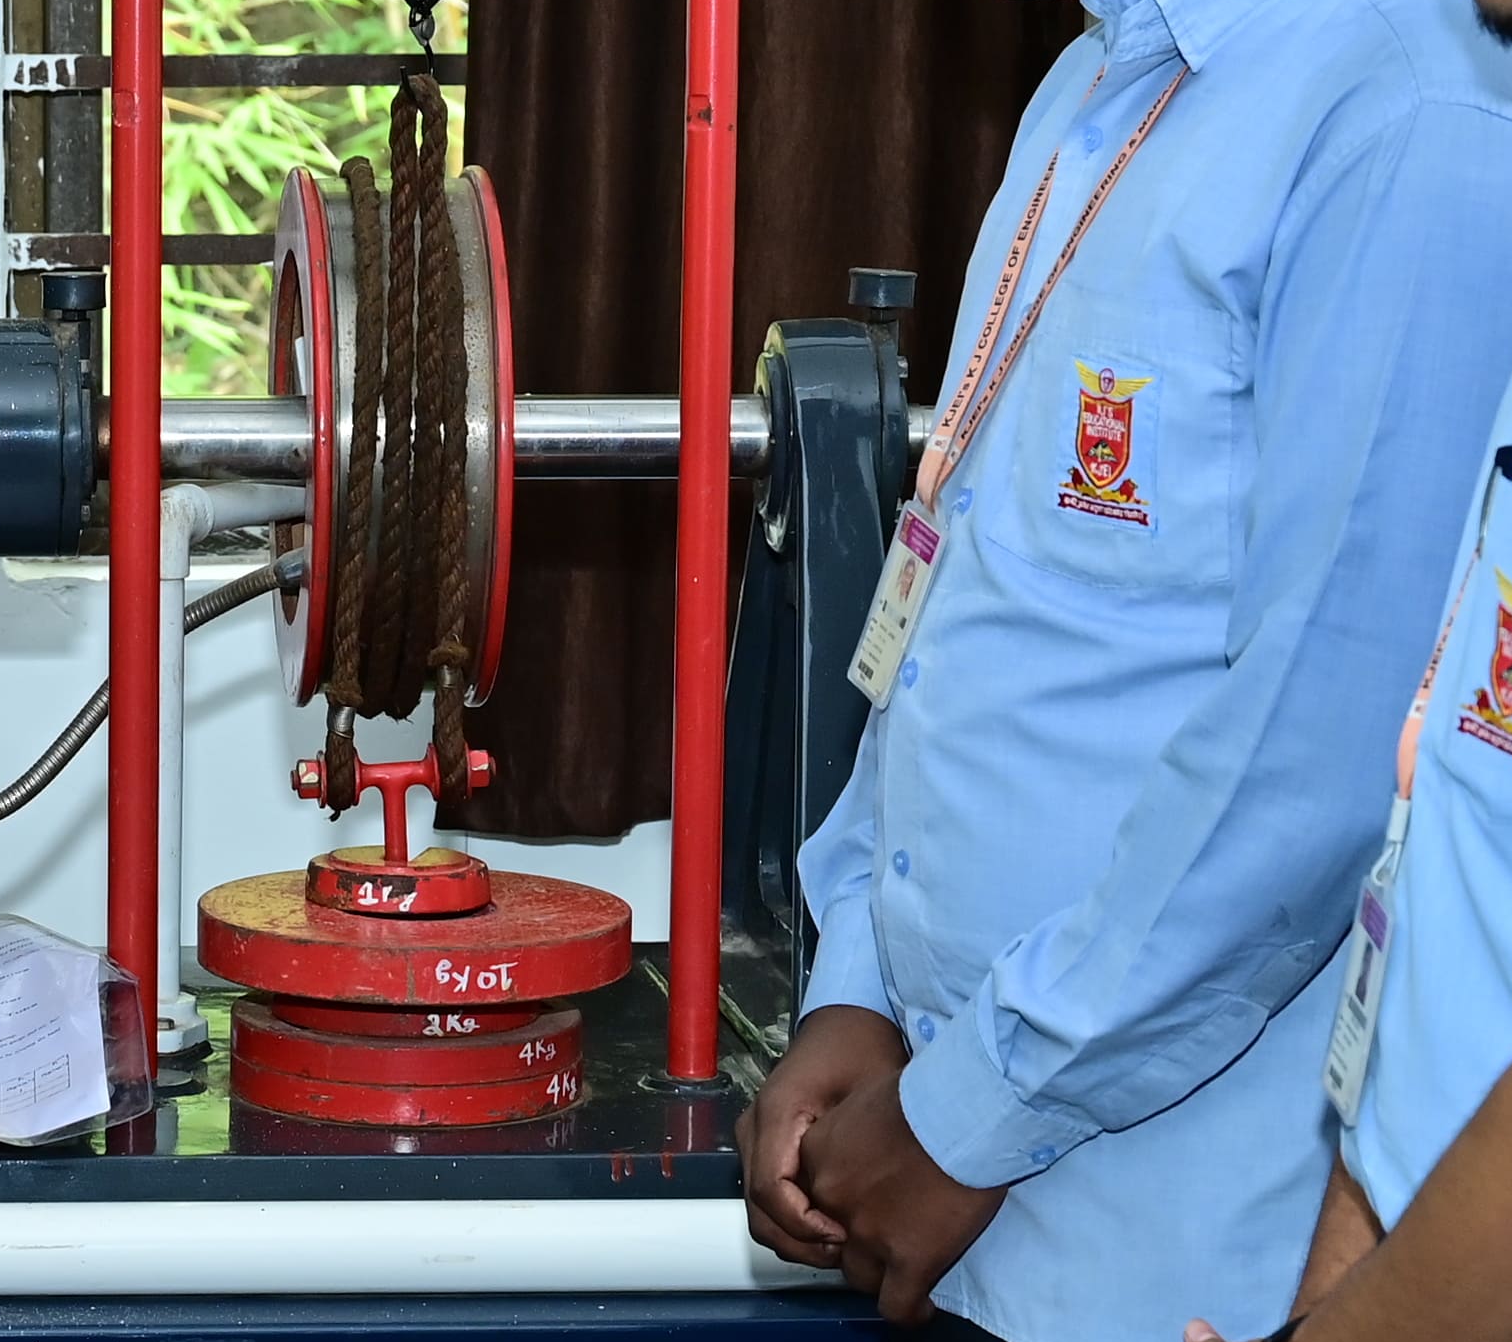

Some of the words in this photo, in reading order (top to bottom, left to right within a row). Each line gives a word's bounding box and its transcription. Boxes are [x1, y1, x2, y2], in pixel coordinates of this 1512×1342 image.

[1057, 149, 1128, 261] ENGINEERING
[964, 363, 978, 379] K
[975, 269, 1014, 350] COLLEGE
[1006, 244, 1023, 269] OF
[1016, 150, 1062, 242] ENGINEER
[519, 1039, 557, 1066] 4Kg
